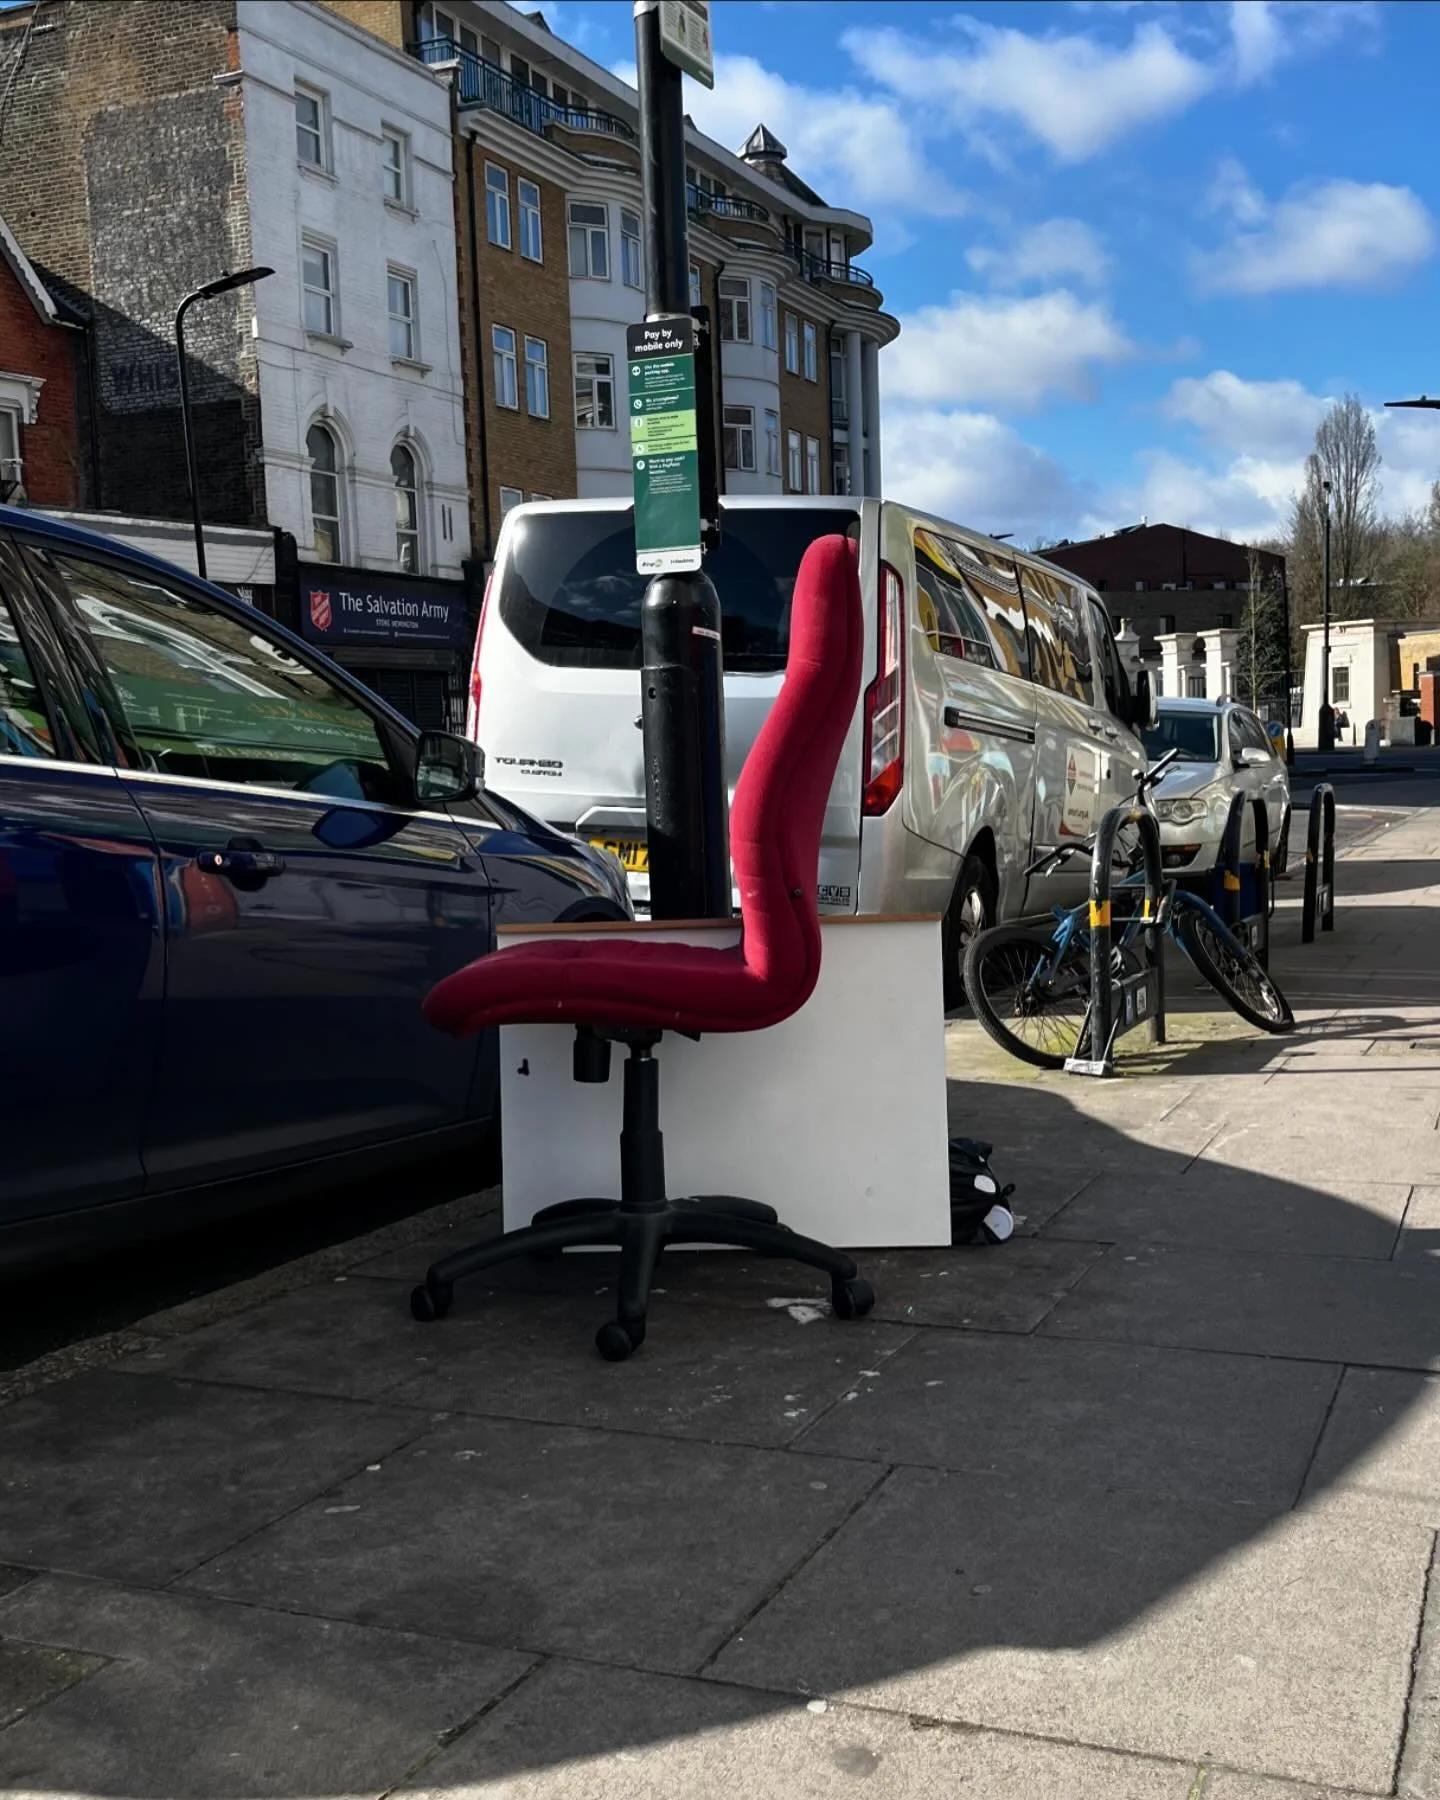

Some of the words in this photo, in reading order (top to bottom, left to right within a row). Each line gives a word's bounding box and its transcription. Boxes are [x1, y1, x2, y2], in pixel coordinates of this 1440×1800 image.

[644, 331, 660, 340] Pay
[661, 328, 672, 339] by
[634, 341, 663, 352] mobile
[664, 338, 683, 350] only
[339, 591, 363, 612] The
[366, 594, 419, 617] Salvation
[421, 600, 449, 622] Army
